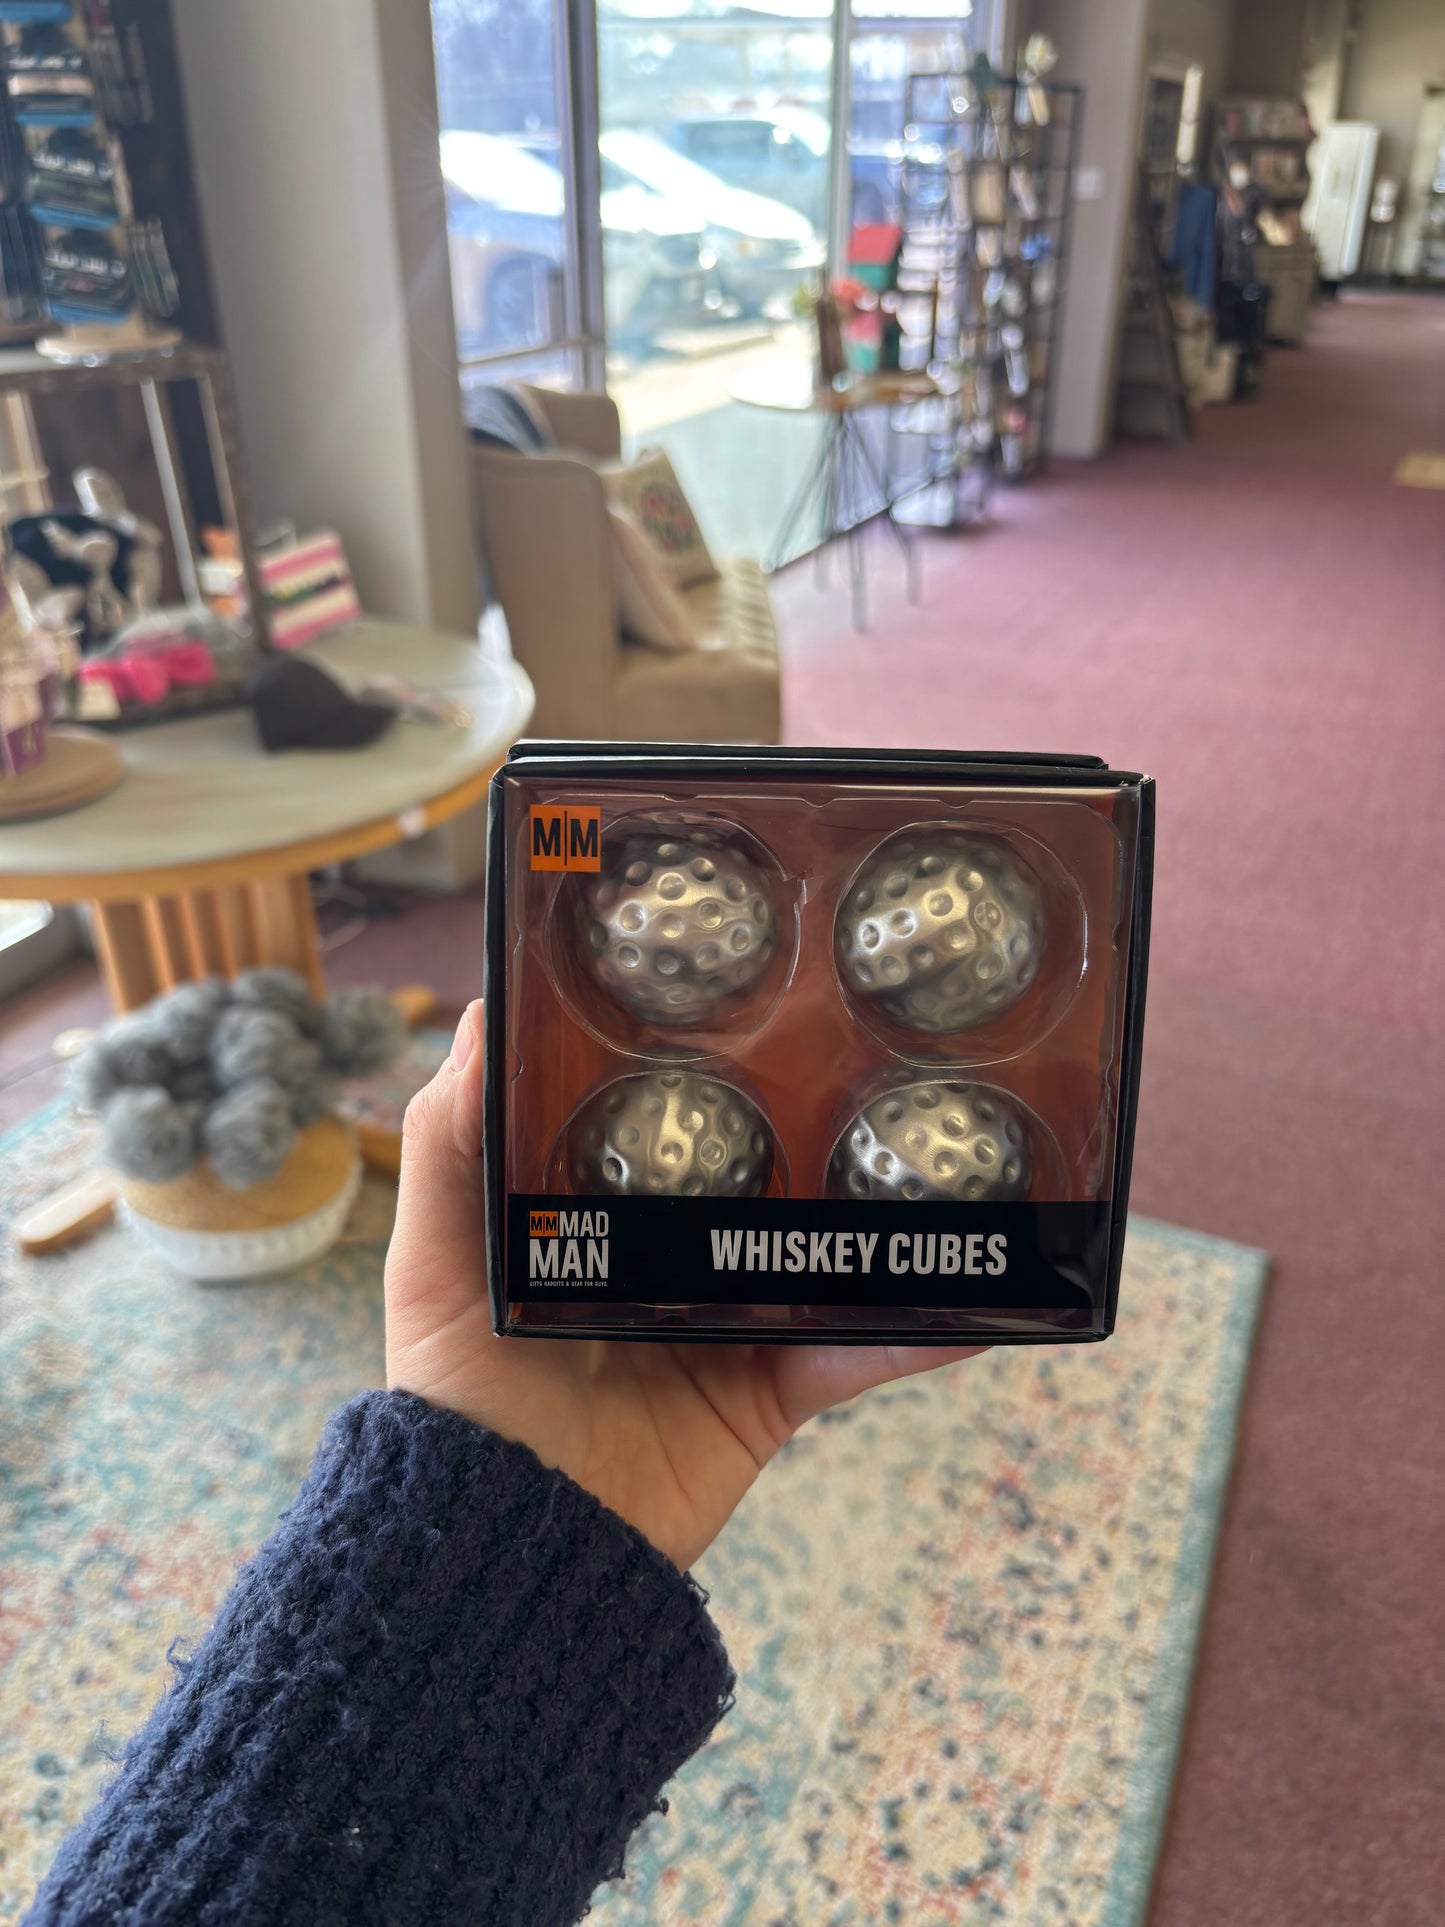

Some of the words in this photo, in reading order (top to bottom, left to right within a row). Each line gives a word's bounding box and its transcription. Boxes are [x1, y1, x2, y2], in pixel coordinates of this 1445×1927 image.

[560, 1211, 609, 1237] MAD
[529, 1239, 609, 1279] MAN
[710, 1229, 879, 1273] WHISKEY
[888, 1233, 1007, 1275] CUBES
